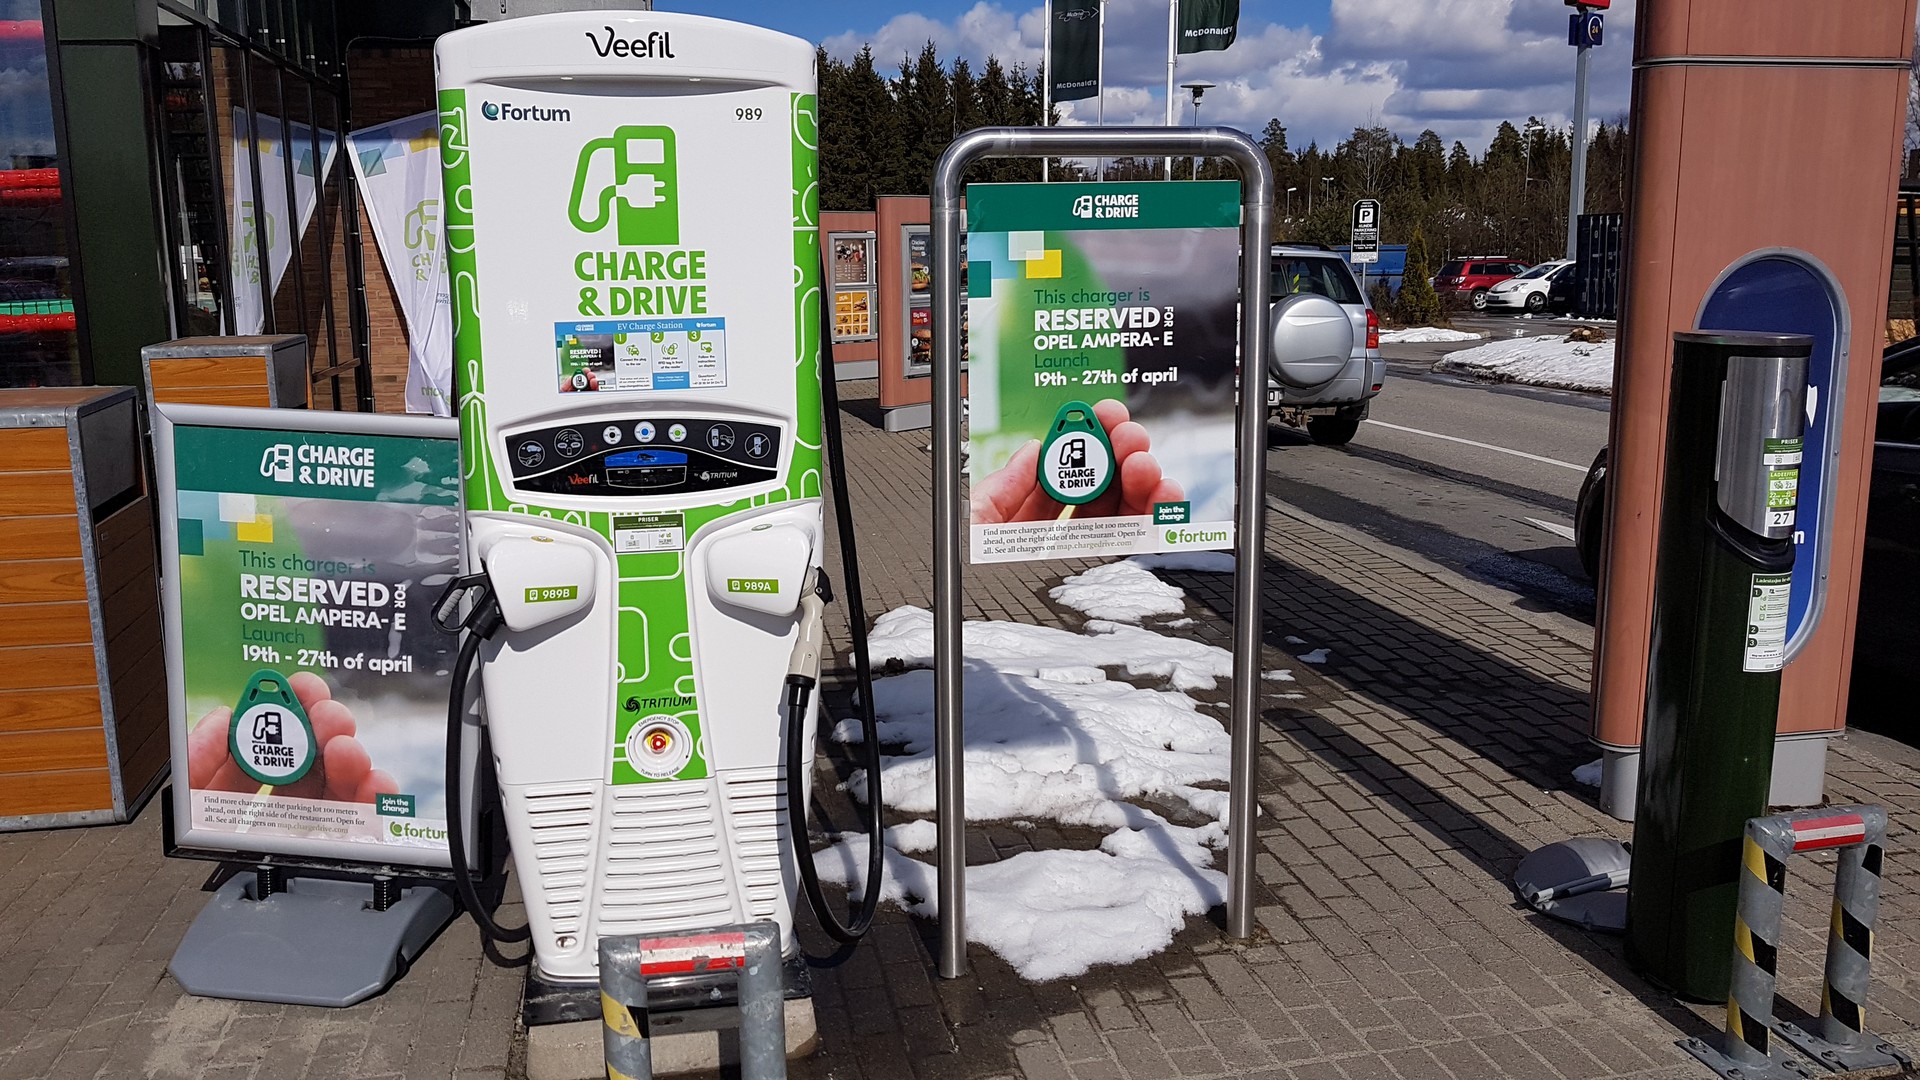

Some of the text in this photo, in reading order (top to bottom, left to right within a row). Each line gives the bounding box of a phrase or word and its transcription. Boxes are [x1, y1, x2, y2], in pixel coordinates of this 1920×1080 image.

[586, 26, 675, 59] Veefil
[1056, 79, 1097, 89] McDonald's
[501, 103, 571, 122] Fortum
[735, 107, 763, 121] 989
[1094, 194, 1139, 206] CHARGE
[1095, 206, 1139, 218] & DRIVE
[1362, 210, 1370, 221] P
[574, 250, 706, 281] CHARGE
[578, 285, 707, 317] & DRIVE
[1034, 287, 1150, 306] This charger is
[1034, 307, 1160, 332] RESERVED
[1164, 306, 1174, 328] FOR
[617, 321, 683, 331] EV Charge Station
[654, 332, 660, 341] 2
[691, 331, 697, 340] 3
[1033, 334, 1077, 350] OPEL
[1034, 352, 1090, 368] Launch
[1034, 371, 1067, 387] 19th
[1082, 369, 1117, 385] 27th
[1121, 369, 1138, 384] of
[1141, 367, 1178, 387] april
[297, 445, 375, 467] CHARGE
[299, 466, 375, 488] & DRIVE
[568, 473, 599, 485] Veefil
[710, 471, 738, 479] TRITIUM
[1058, 468, 1095, 479] CHARGE
[1059, 478, 1095, 489] & DRIVE
[1158, 506, 1173, 514] Join
[1158, 513, 1185, 521] change
[1773, 513, 1790, 525] 27
[983, 528, 998, 536] Find
[1018, 527, 1047, 535] chargers
[1067, 523, 1094, 532] parking
[1179, 528, 1227, 543] fortum
[983, 537, 1005, 545] ahead,
[1028, 535, 1045, 543] right
[1080, 531, 1116, 539] restaurant.
[1117, 530, 1135, 538] Open
[995, 546, 1006, 554] See
[1017, 545, 1045, 553] chargers
[1056, 540, 1132, 551] map.chargedrive.com
[239, 550, 376, 576] This charger is
[240, 574, 390, 607] RESERVED
[744, 581, 771, 591] 989A
[394, 584, 406, 608] FOR
[542, 589, 570, 599] 989B
[240, 603, 290, 624] OPEL
[242, 624, 305, 644] Launch
[242, 645, 280, 663] 19th
[298, 650, 338, 669] 27th
[343, 653, 363, 670] of
[368, 655, 412, 675] april
[641, 696, 692, 709] TRITIUM
[638, 716, 680, 727] EMERGENCY STOP
[252, 744, 294, 757] CHARGE
[254, 755, 295, 768] & DRIVE
[238, 798, 266, 808] chargers
[286, 803, 312, 813] parking
[382, 796, 409, 807] Join the
[204, 805, 226, 815] ahead,
[248, 809, 265, 818] right
[299, 814, 335, 823] restaurant.
[336, 816, 354, 826] Open
[355, 818, 366, 826] for
[382, 804, 409, 814] change
[237, 818, 266, 827] chargers
[277, 822, 348, 834] map.chargedrive.com
